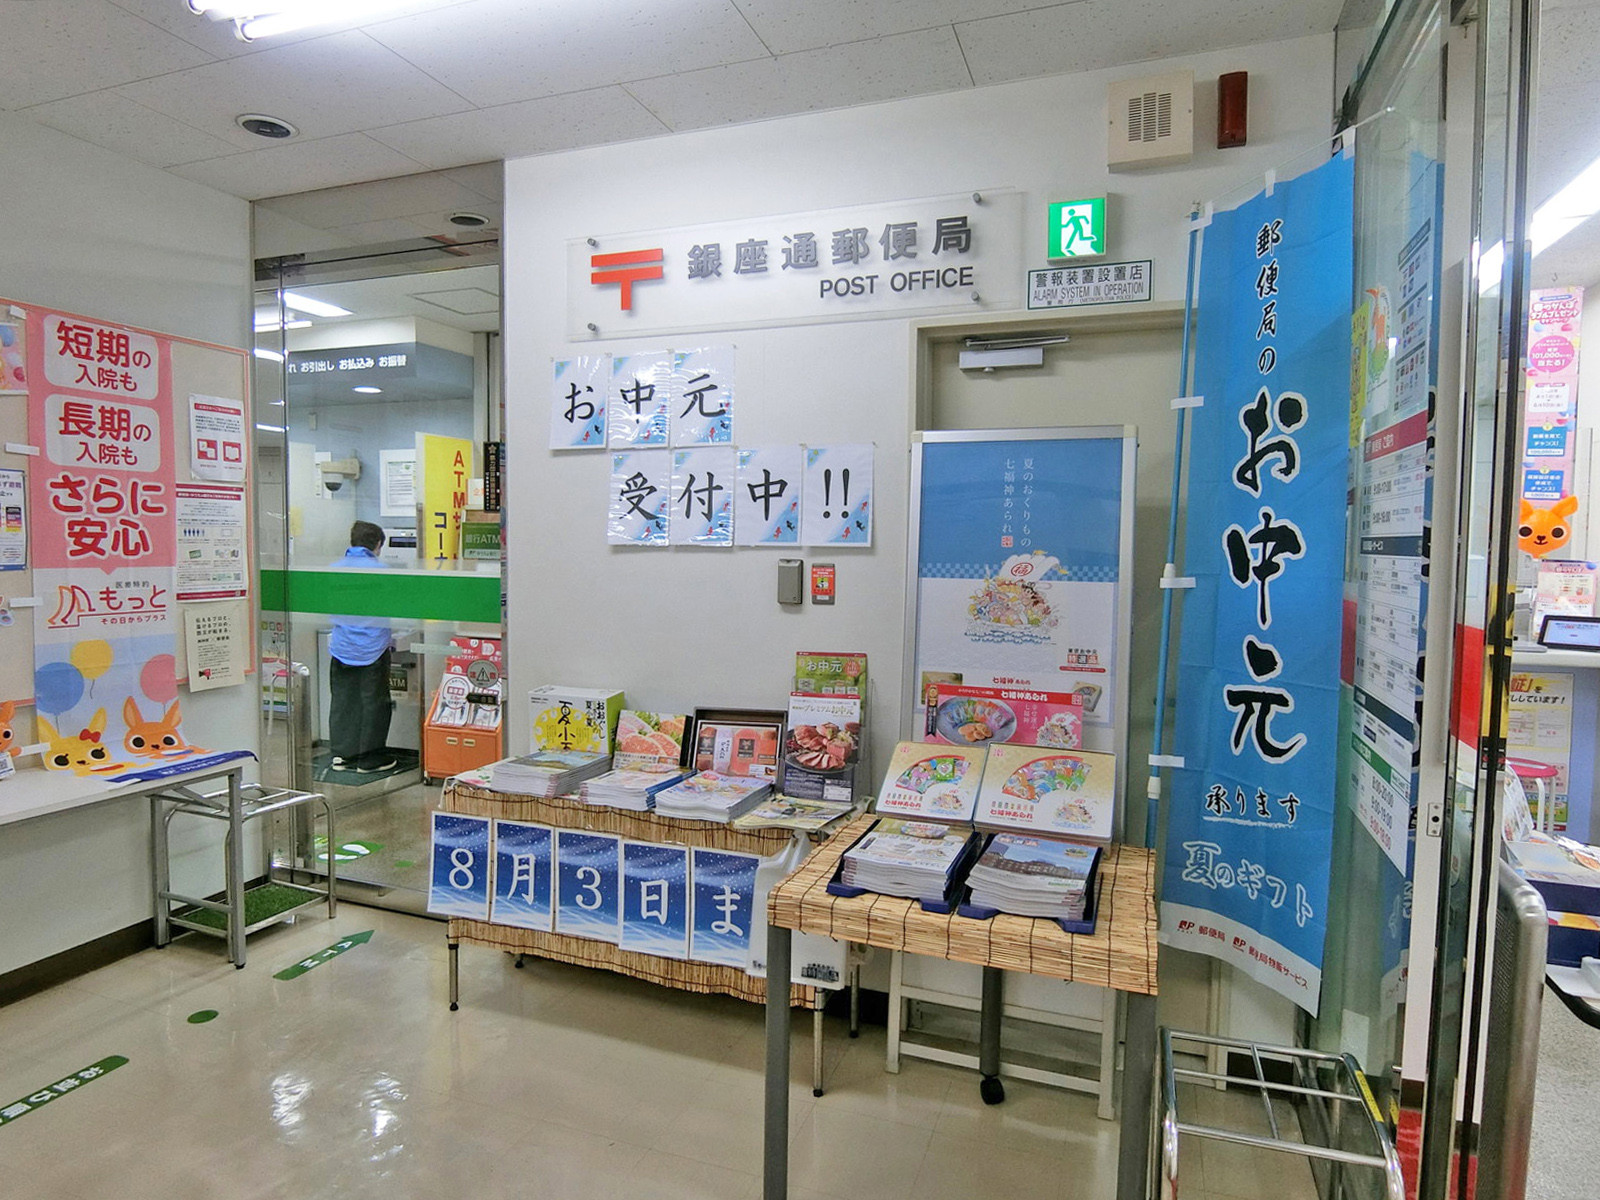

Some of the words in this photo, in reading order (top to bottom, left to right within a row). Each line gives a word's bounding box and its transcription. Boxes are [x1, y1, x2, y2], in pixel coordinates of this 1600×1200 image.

[688, 215, 972, 279] 銀座通郵便局
[820, 275, 878, 298] POST
[890, 266, 974, 292] OFFICE
[1034, 290, 1058, 300] ALARM
[1061, 287, 1090, 299] SYSTEM
[1093, 286, 1101, 296] IN
[1104, 281, 1144, 296] OPERATION
[1035, 265, 1143, 288] 警報装置設置店
[1256, 219, 1283, 374] 郵便局の
[56, 320, 152, 369] 短期の
[75, 364, 138, 391] 入院も
[300, 361, 335, 373] お引出し
[564, 374, 727, 424] お中元
[58, 402, 152, 442] 長期の
[76, 440, 138, 465] 入院も
[50, 475, 165, 515] さらに
[618, 468, 850, 522] 受付中!!
[1002, 458, 1015, 533] 七福神あられ
[1021, 458, 1034, 547] 夏のおくりもの
[67, 518, 151, 557] 安心
[1224, 383, 1310, 764] お中元
[99, 585, 166, 611] もっと
[101, 614, 167, 625] その日からプラス
[806, 660, 843, 672] お中元
[1205, 784, 1301, 823] 承ります
[448, 848, 745, 938] 8月3日ま
[1182, 841, 1313, 928] 夏のギフト
[1198, 925, 1226, 942] 郵便局
